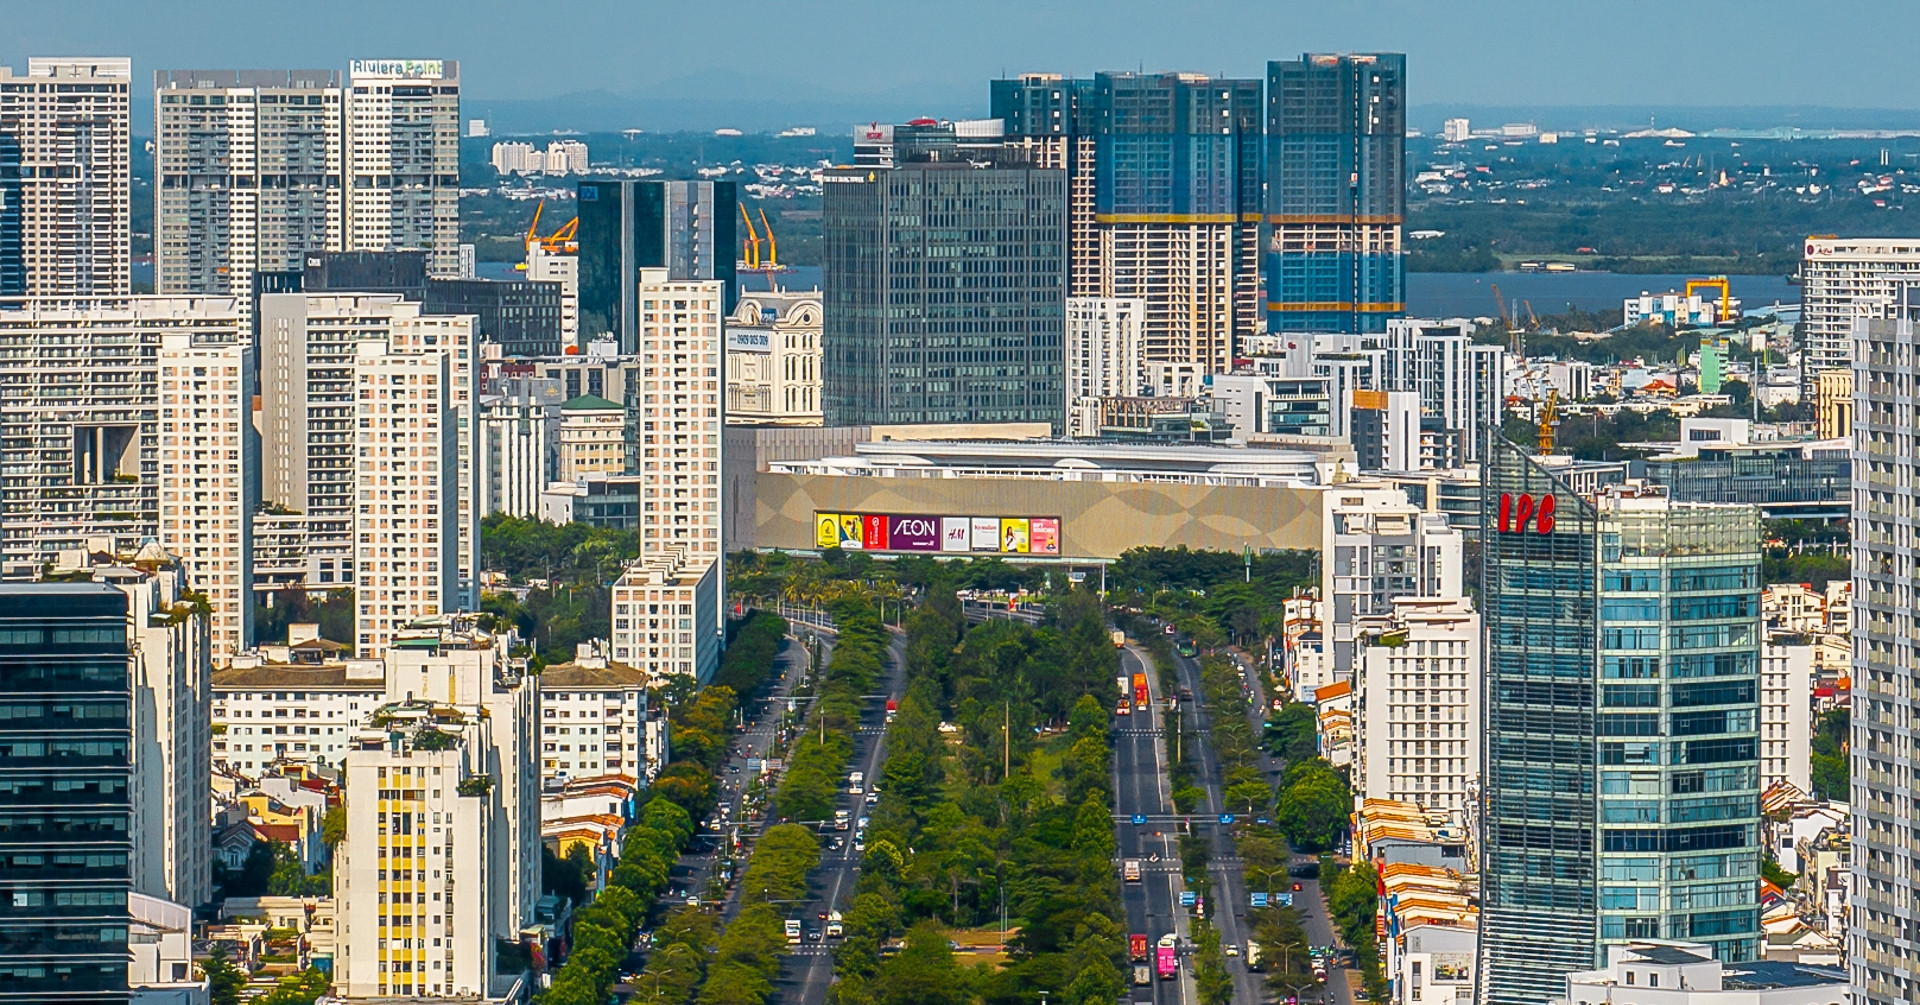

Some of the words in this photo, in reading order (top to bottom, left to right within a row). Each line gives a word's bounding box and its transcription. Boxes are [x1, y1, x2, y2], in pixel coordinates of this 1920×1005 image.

[353, 60, 403, 75] Riviera
[405, 60, 443, 75] Point
[1498, 492, 1555, 535] IPC
